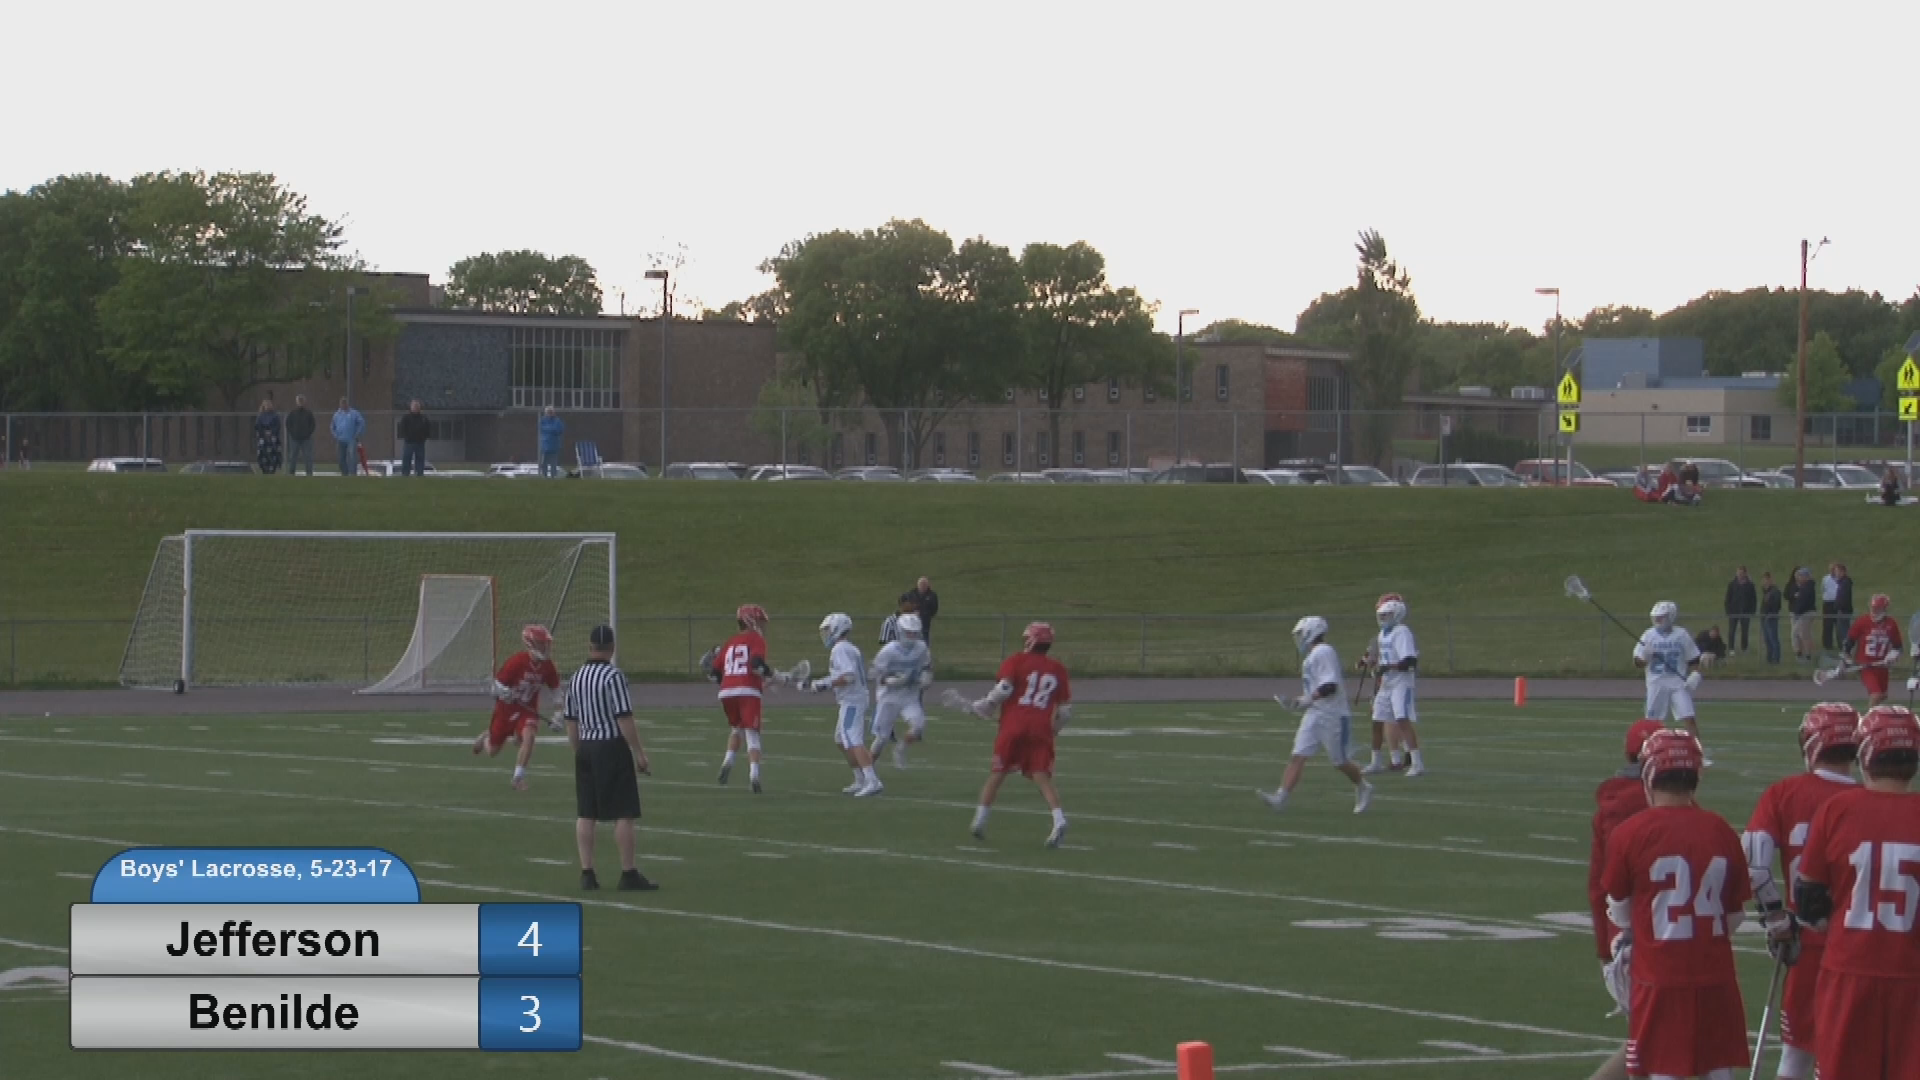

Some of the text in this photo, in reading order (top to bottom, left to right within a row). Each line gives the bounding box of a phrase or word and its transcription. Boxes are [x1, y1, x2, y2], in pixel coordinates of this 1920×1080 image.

[724, 644, 748, 675] 42
[1865, 635, 1889, 657] 27
[1018, 671, 1057, 709] 18
[1649, 856, 1727, 941] 24
[1844, 842, 1920, 932] 15
